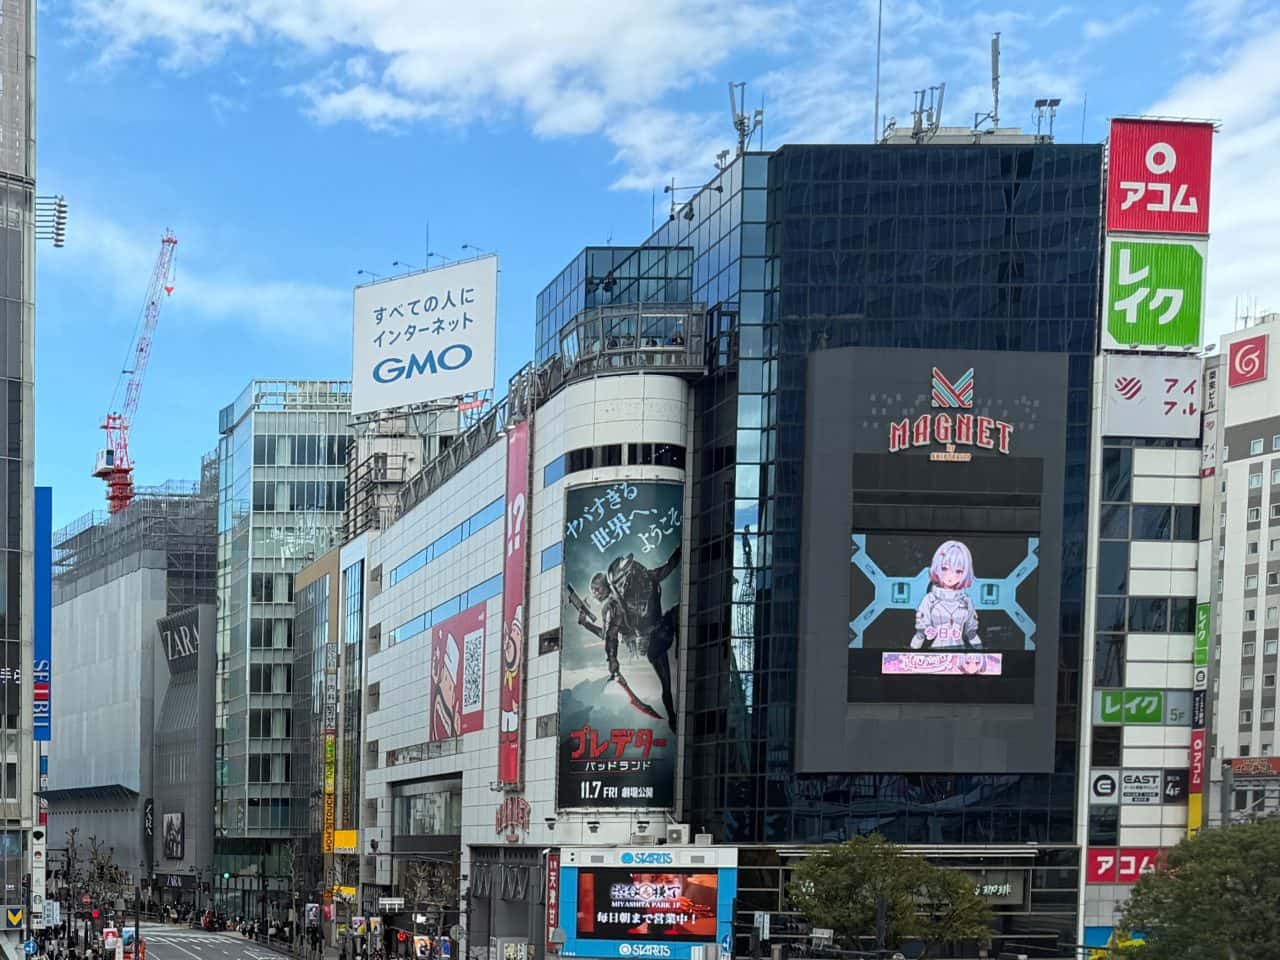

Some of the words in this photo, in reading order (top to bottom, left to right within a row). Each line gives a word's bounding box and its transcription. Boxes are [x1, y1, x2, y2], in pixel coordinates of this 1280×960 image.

[1119, 181, 1198, 214] アコム
[373, 287, 475, 326] すべての人に
[372, 311, 474, 348] インターネット
[372, 343, 473, 384] GMO
[888, 412, 1014, 455] MAGNET
[566, 481, 638, 539] ヤバすぎる
[637, 507, 681, 553] ようこそ
[163, 623, 200, 661] ZARA
[1105, 695, 1159, 714] レイク
[1170, 708, 1185, 722] 5F
[569, 724, 668, 760] プレデター
[585, 760, 652, 772] バッドランド
[1123, 775, 1159, 784] EAST
[581, 780, 602, 799] 11.7
[603, 786, 618, 799] FRI
[1096, 855, 1156, 875] アコム
